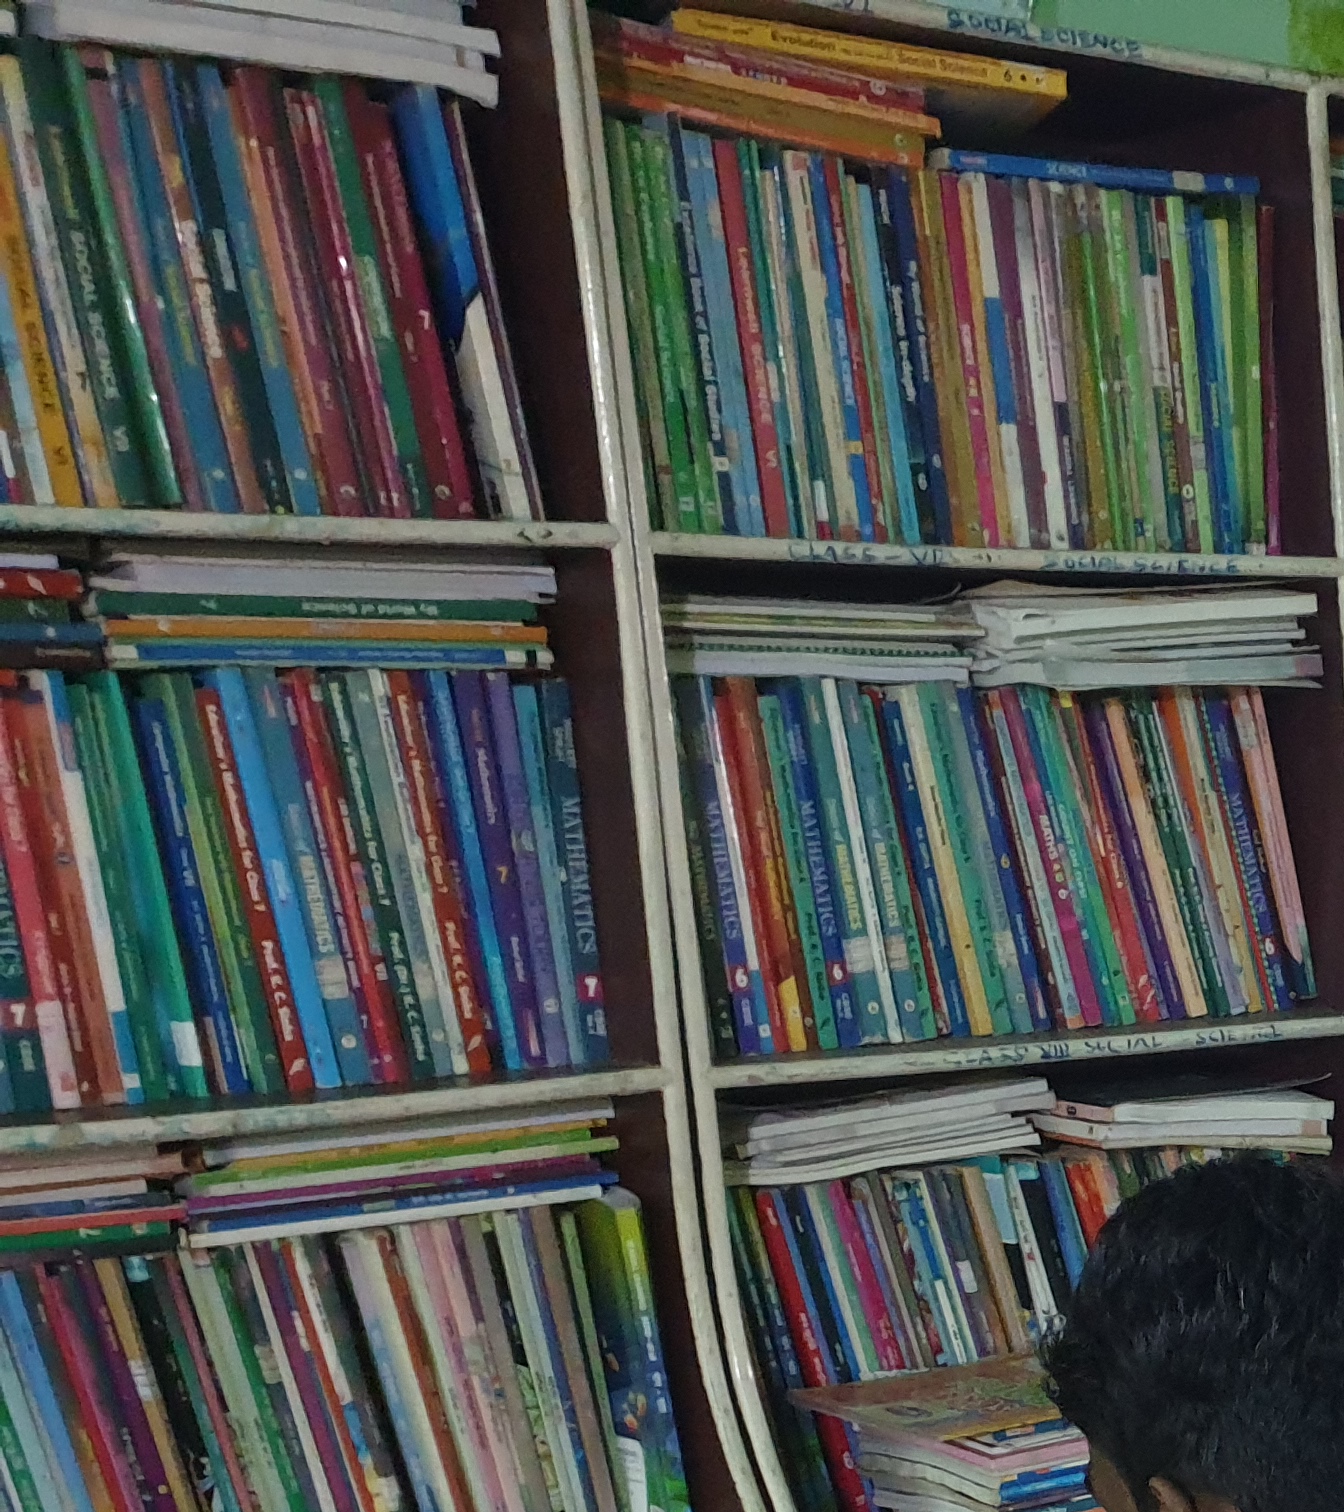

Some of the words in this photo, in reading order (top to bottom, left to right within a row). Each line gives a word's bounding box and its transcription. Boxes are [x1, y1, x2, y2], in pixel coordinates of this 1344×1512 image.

[945, 7, 1030, 41] SOCIAL
[1038, 25, 1142, 58] SCIENCE
[66, 228, 97, 302] SOCIAL
[83, 309, 120, 400] SCIENCE
[561, 795, 597, 955] MATHEMATICS
[583, 974, 598, 998] 7
[705, 800, 741, 939] MATHEMATICS
[734, 967, 749, 989] 6
[798, 798, 838, 937] MATHEMATICS
[831, 963, 844, 980] 6
[834, 843, 862, 930] MATHEMATICS
[873, 841, 900, 927] MATHEMATICS
[1036, 813, 1059, 860] MATHS
[1228, 791, 1267, 913] MATHEMATICS
[1262, 937, 1276, 956] 6
